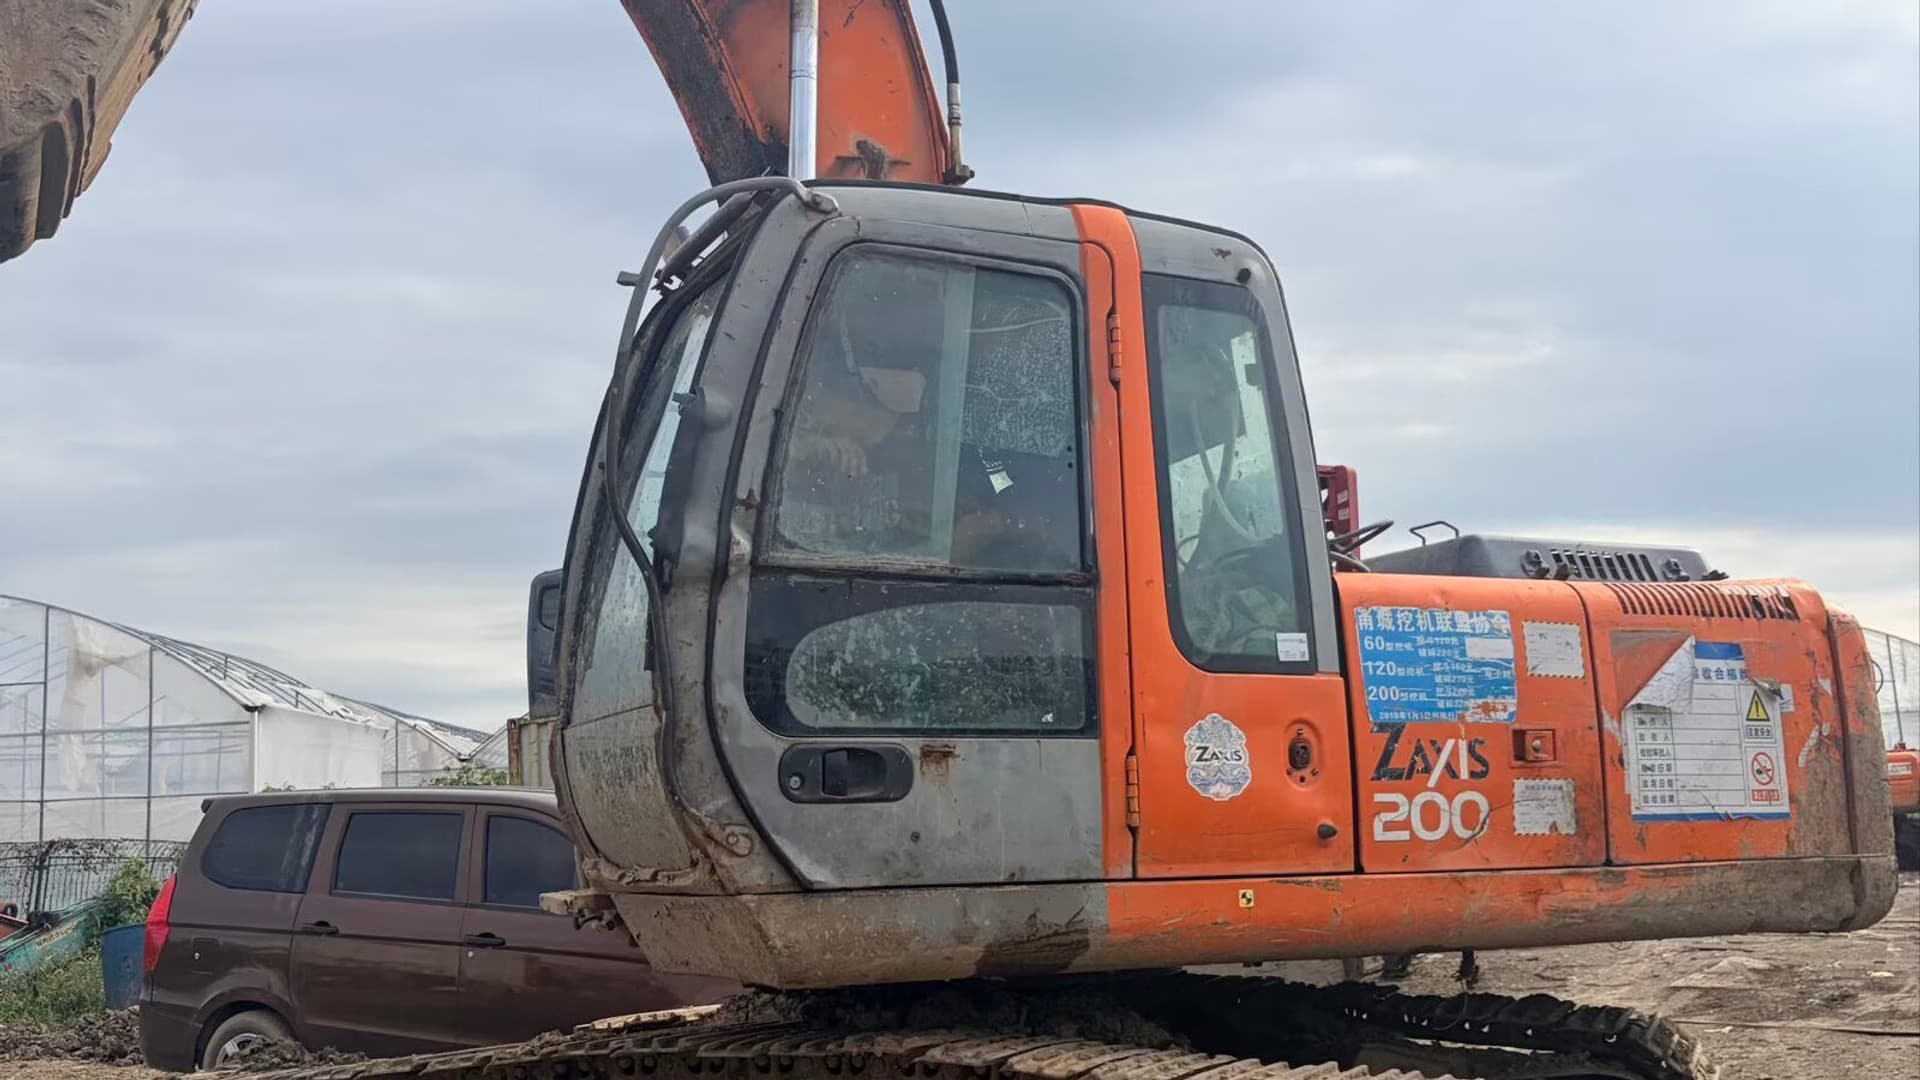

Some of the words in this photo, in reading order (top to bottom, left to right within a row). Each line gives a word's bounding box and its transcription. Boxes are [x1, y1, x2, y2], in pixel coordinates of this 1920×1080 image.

[1195, 746, 1242, 762] ZAXIS
[1370, 722, 1490, 787] ZAXIS
[1374, 791, 1490, 841] 200
